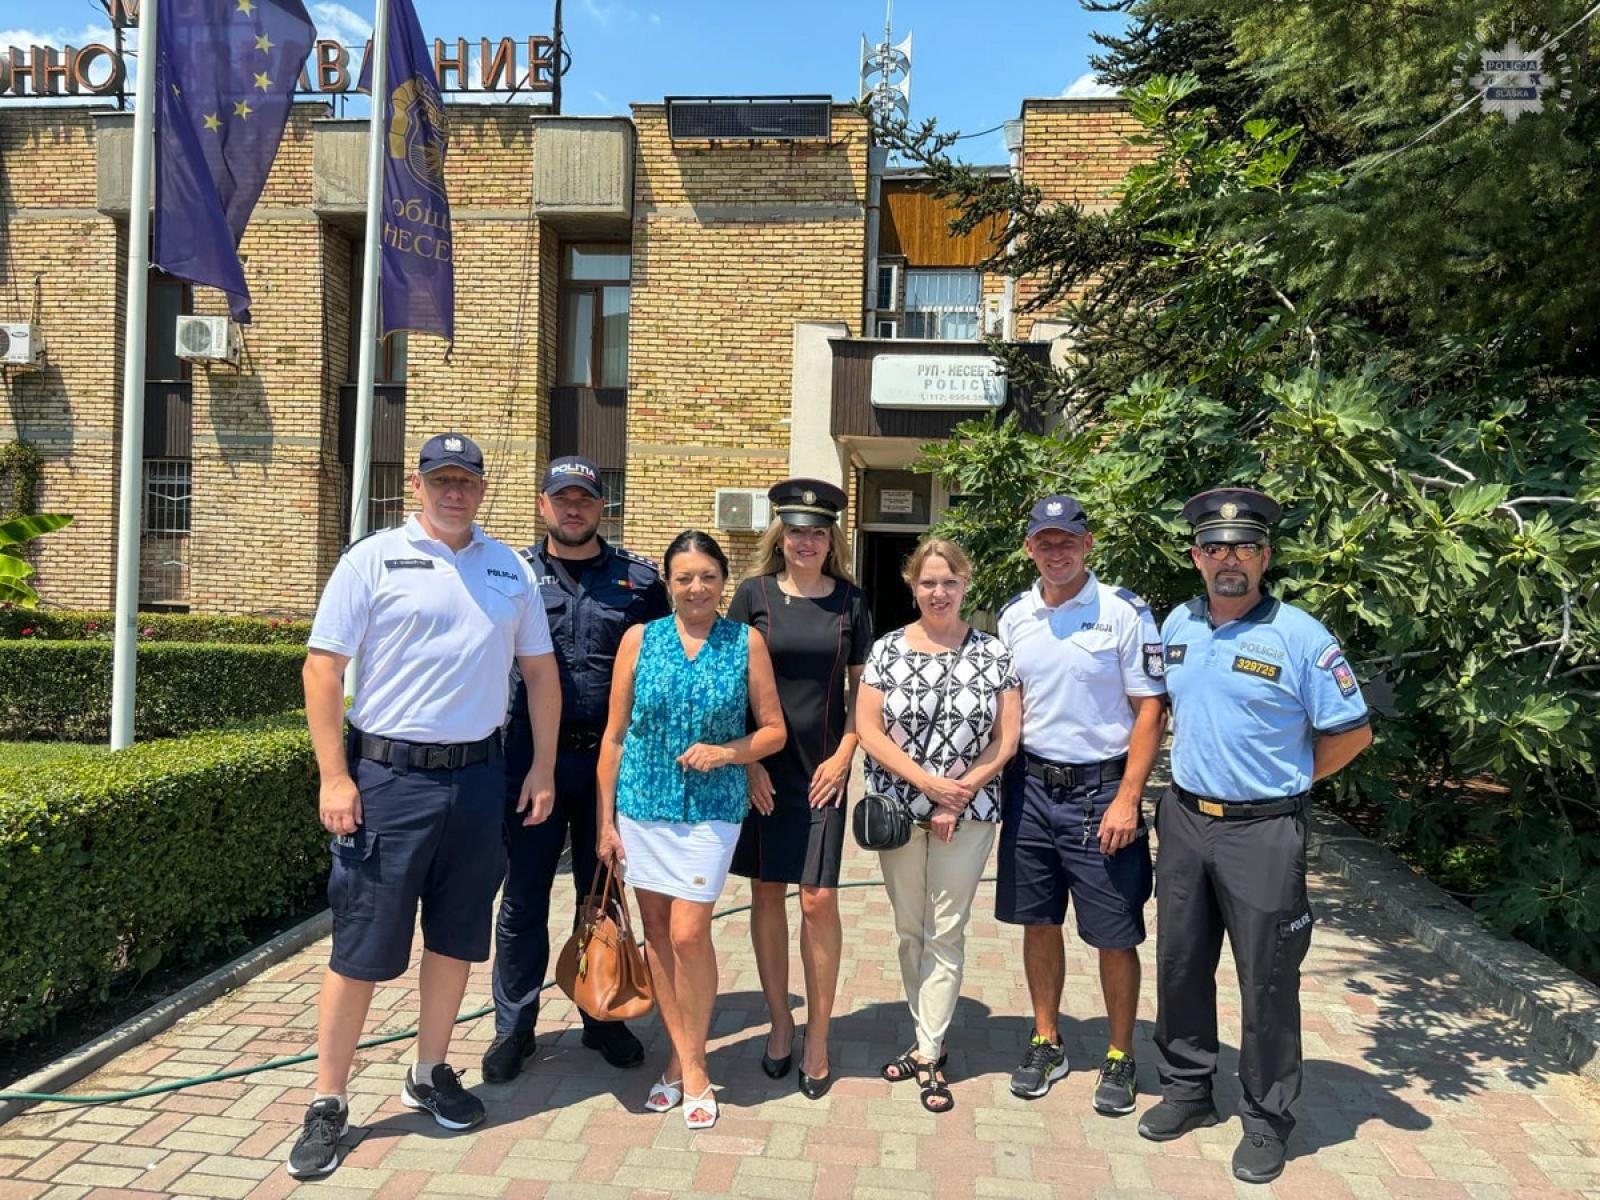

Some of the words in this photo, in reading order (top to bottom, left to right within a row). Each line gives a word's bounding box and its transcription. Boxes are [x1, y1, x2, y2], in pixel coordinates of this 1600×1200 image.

[924, 379, 993, 391] POLICE
[487, 568, 519, 581] POLICJA
[1080, 621, 1112, 633] POLICJA
[1236, 658, 1277, 678] 329725
